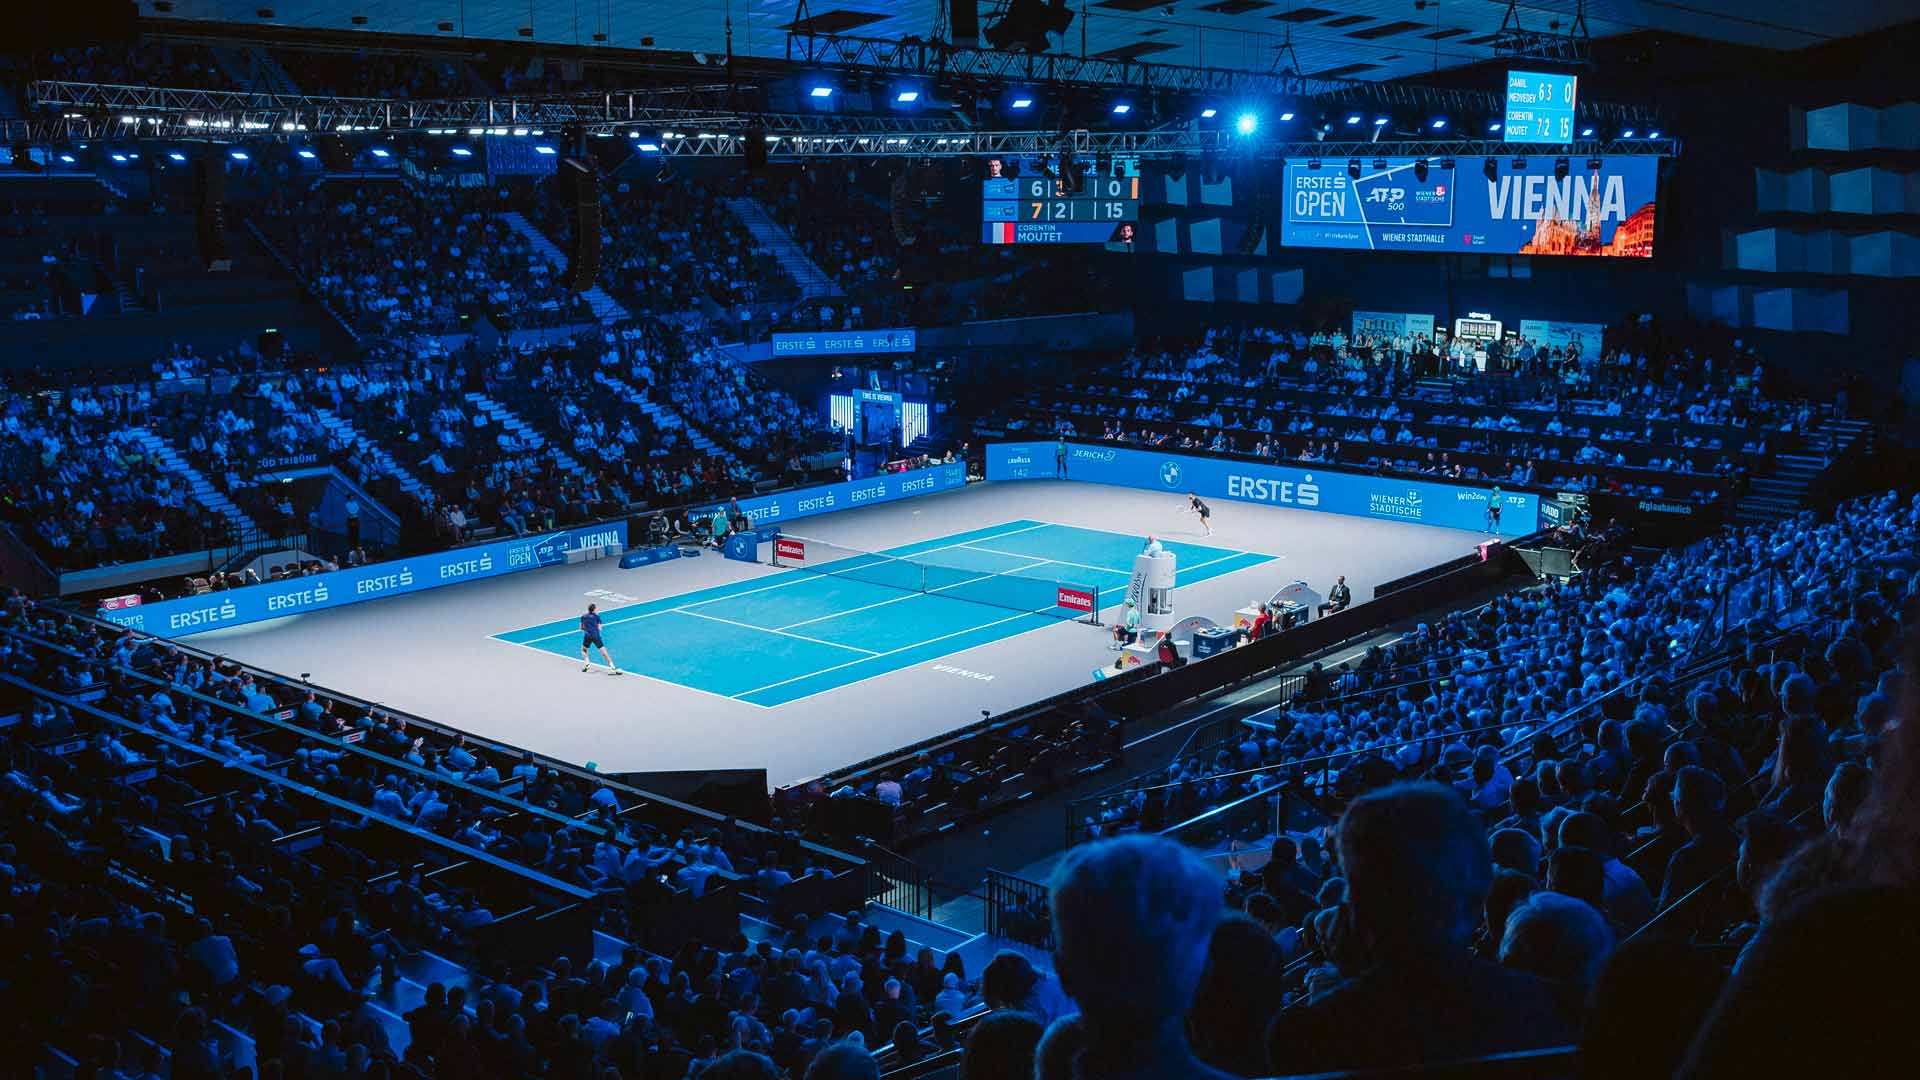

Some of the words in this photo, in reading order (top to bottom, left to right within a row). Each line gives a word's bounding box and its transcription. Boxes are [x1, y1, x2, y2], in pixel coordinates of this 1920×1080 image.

[1510, 93, 1536, 104] MEDVEDEV
[1538, 82, 1544, 100] 6
[1546, 84, 1552, 101] 3
[1564, 82, 1571, 103] 0
[1508, 112, 1534, 120] CORENTIN
[1507, 126, 1528, 136] MOUTET
[1538, 118, 1542, 136] 7
[1544, 118, 1550, 136] 2
[1560, 118, 1568, 138] 15
[1032, 181, 1043, 197] 6
[1108, 180, 1120, 196] 0
[1296, 176, 1332, 188] ERSTE
[1366, 188, 1405, 202] ATP
[1488, 176, 1626, 221] VIENNA
[1032, 202, 1042, 218] 7
[1055, 202, 1066, 218] 2
[1106, 202, 1122, 218] 15
[1296, 191, 1345, 216] OPEN
[1018, 232, 1062, 241] MOUTET
[1382, 233, 1406, 242] WIENER
[1407, 234, 1446, 244] STADTHALLE
[776, 340, 805, 350] ERSTE
[824, 340, 854, 349] ERSTE
[872, 338, 899, 348] ERSTE
[1073, 449, 1104, 460] JERICH
[902, 479, 927, 492] ERSTE
[1228, 475, 1294, 502] ERSTE
[852, 488, 876, 502] ERSTE
[1370, 493, 1406, 505] WIENER
[798, 496, 824, 512] ERSTE
[1542, 504, 1558, 518] RADO
[580, 530, 618, 548] VIENNA
[778, 544, 804, 555] Emirates
[510, 552, 530, 567] OPEN
[440, 560, 478, 578] ERSTE
[357, 574, 398, 594] ERSTE
[268, 590, 312, 610] ERSTE
[1059, 592, 1091, 607] Emirates
[170, 608, 218, 629] ERSTE
[932, 664, 995, 680] VIENNA
